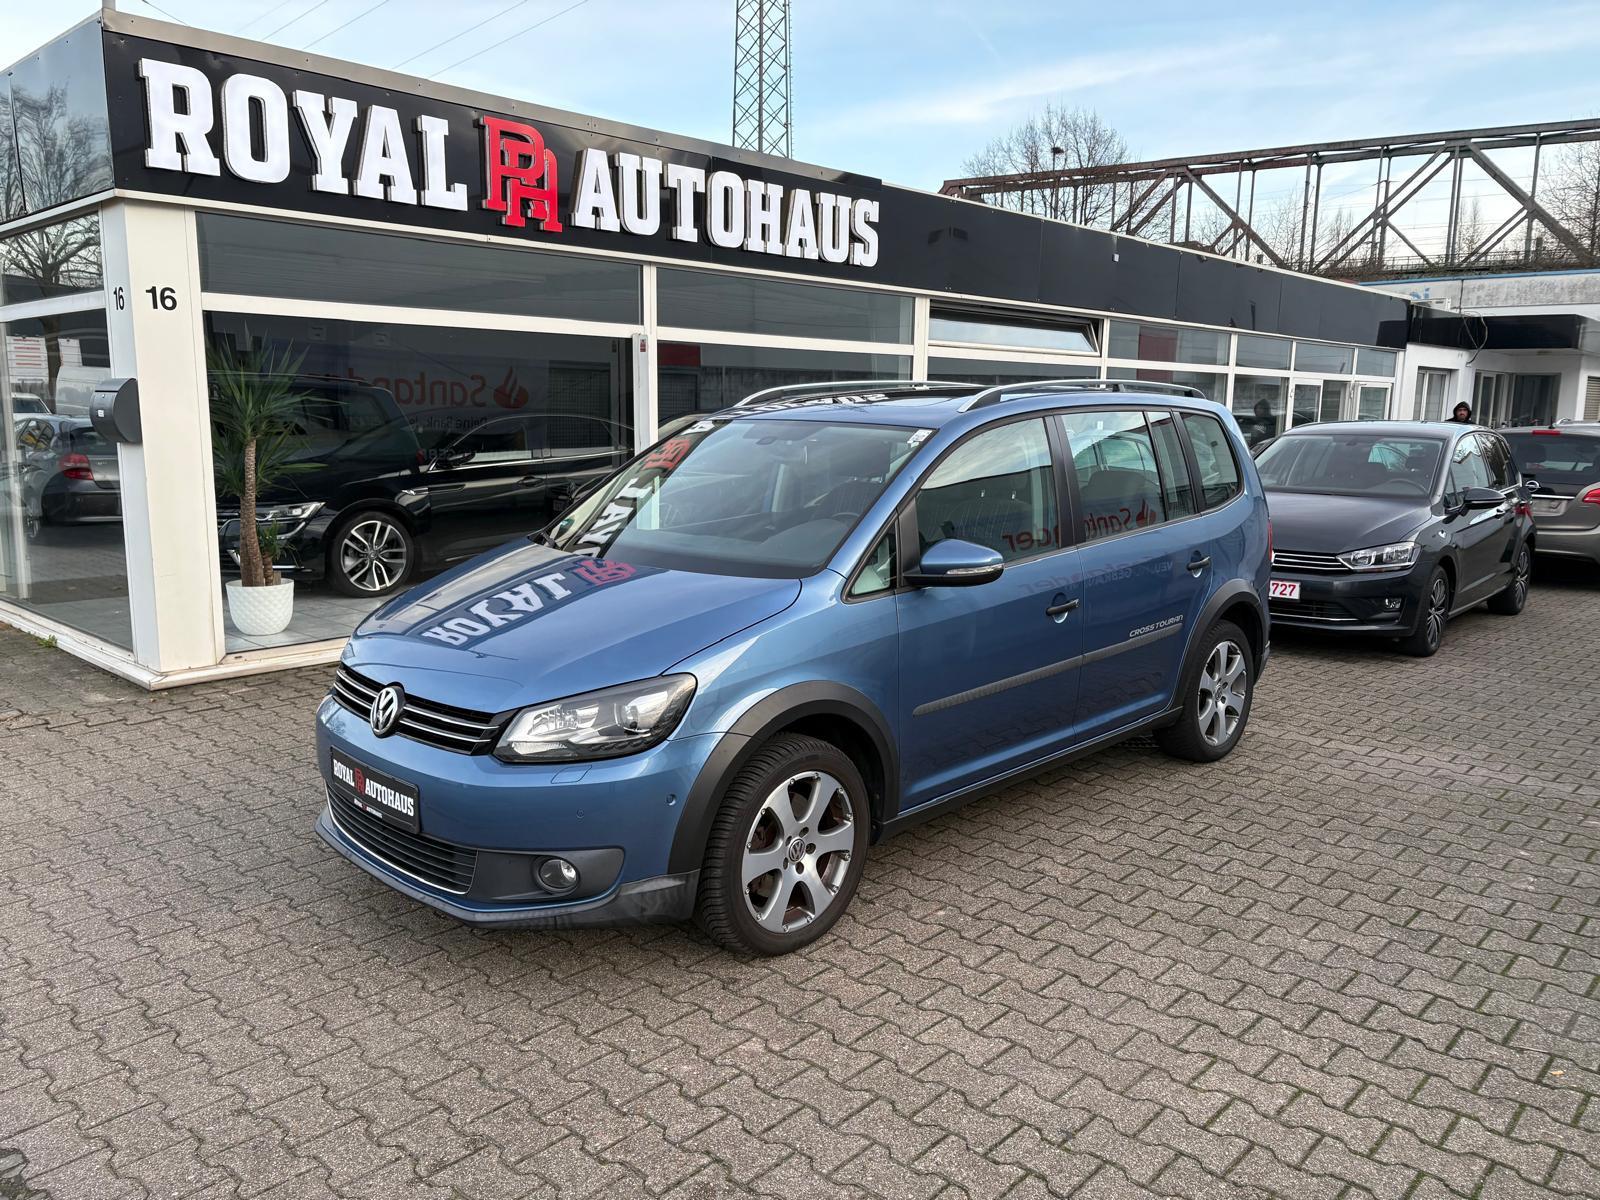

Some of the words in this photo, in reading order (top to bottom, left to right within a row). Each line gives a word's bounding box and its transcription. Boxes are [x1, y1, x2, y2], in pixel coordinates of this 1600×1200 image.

[138, 58, 469, 211] ROYAL
[570, 148, 880, 267] AUTOHAUS
[113, 286, 125, 311] 16
[146, 286, 178, 311] 16
[1272, 582, 1297, 597] 727
[333, 758, 355, 787] ROYAL
[365, 778, 415, 817] AUTOHAUS
